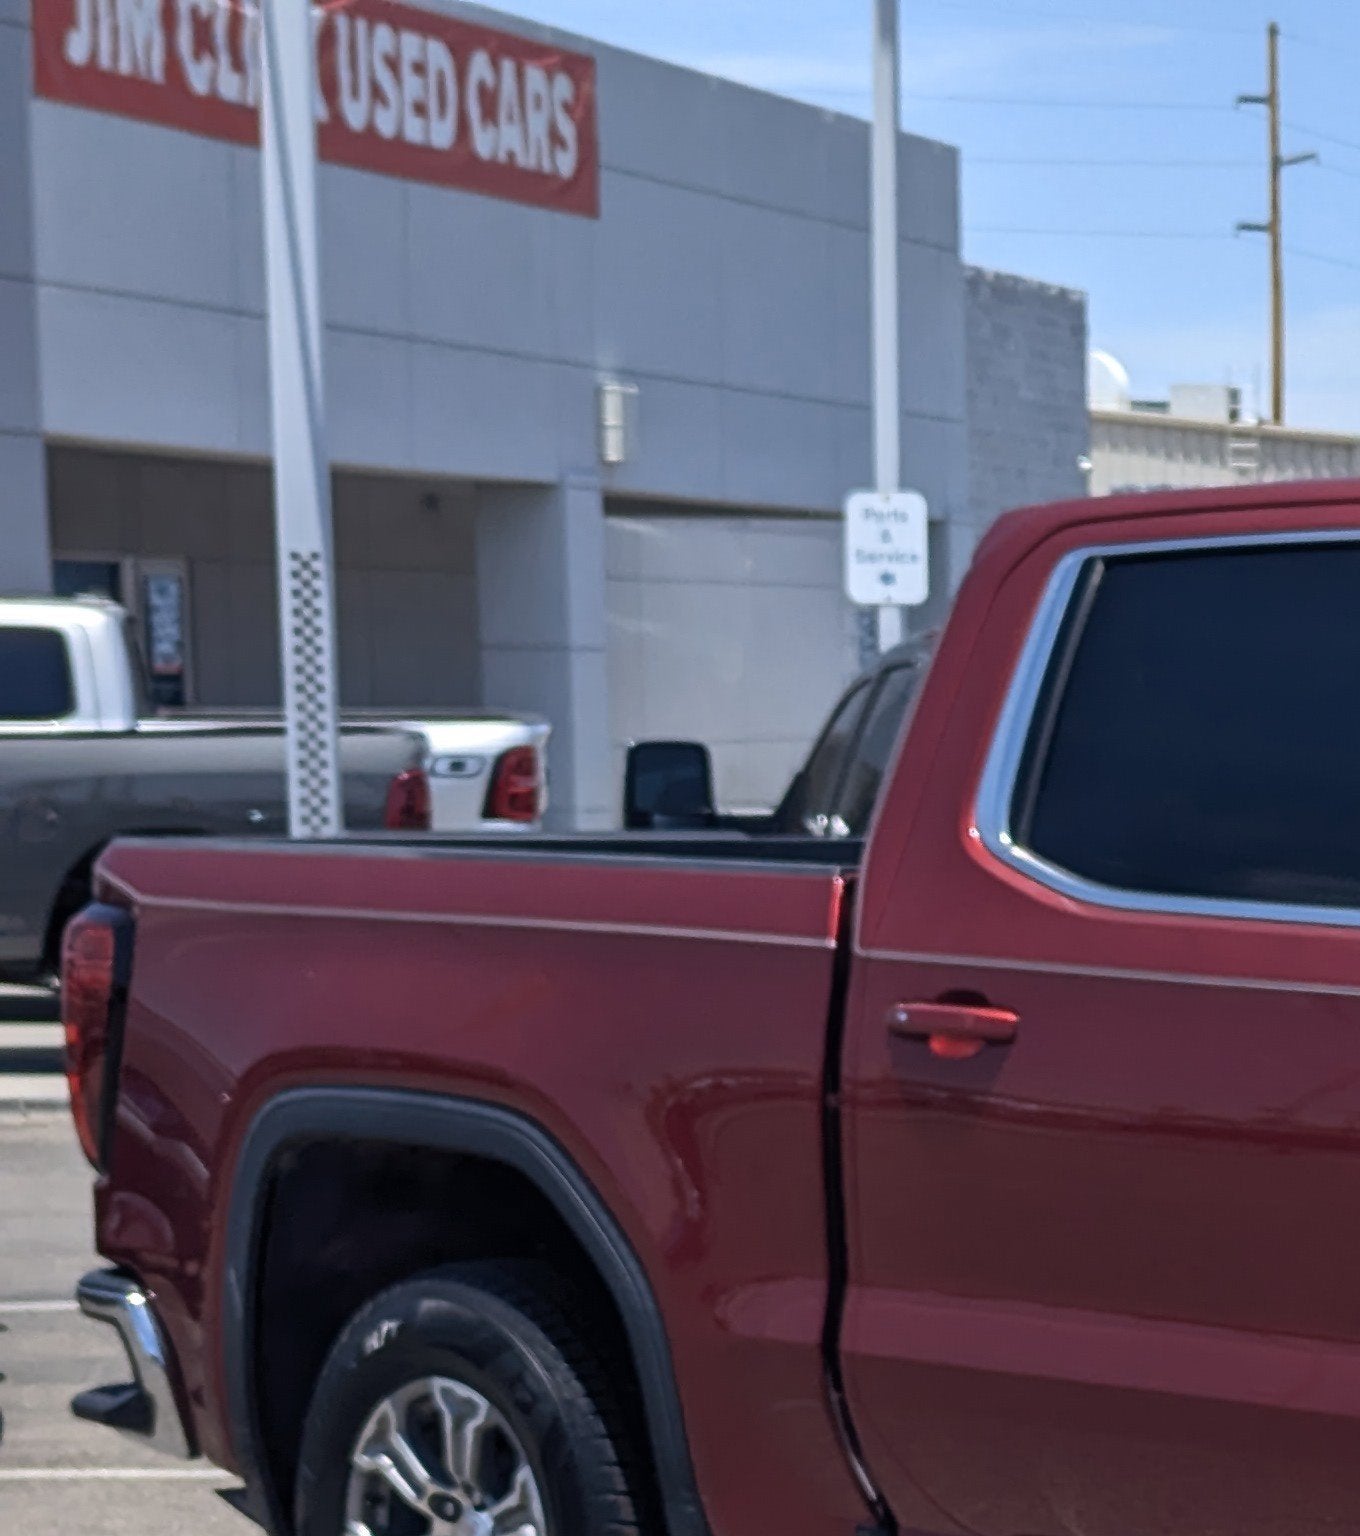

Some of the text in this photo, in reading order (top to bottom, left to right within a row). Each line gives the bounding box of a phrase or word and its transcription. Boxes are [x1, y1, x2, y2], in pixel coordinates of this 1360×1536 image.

[66, 0, 166, 84] JIM
[334, 12, 458, 150] USED
[467, 48, 578, 180] CARS
